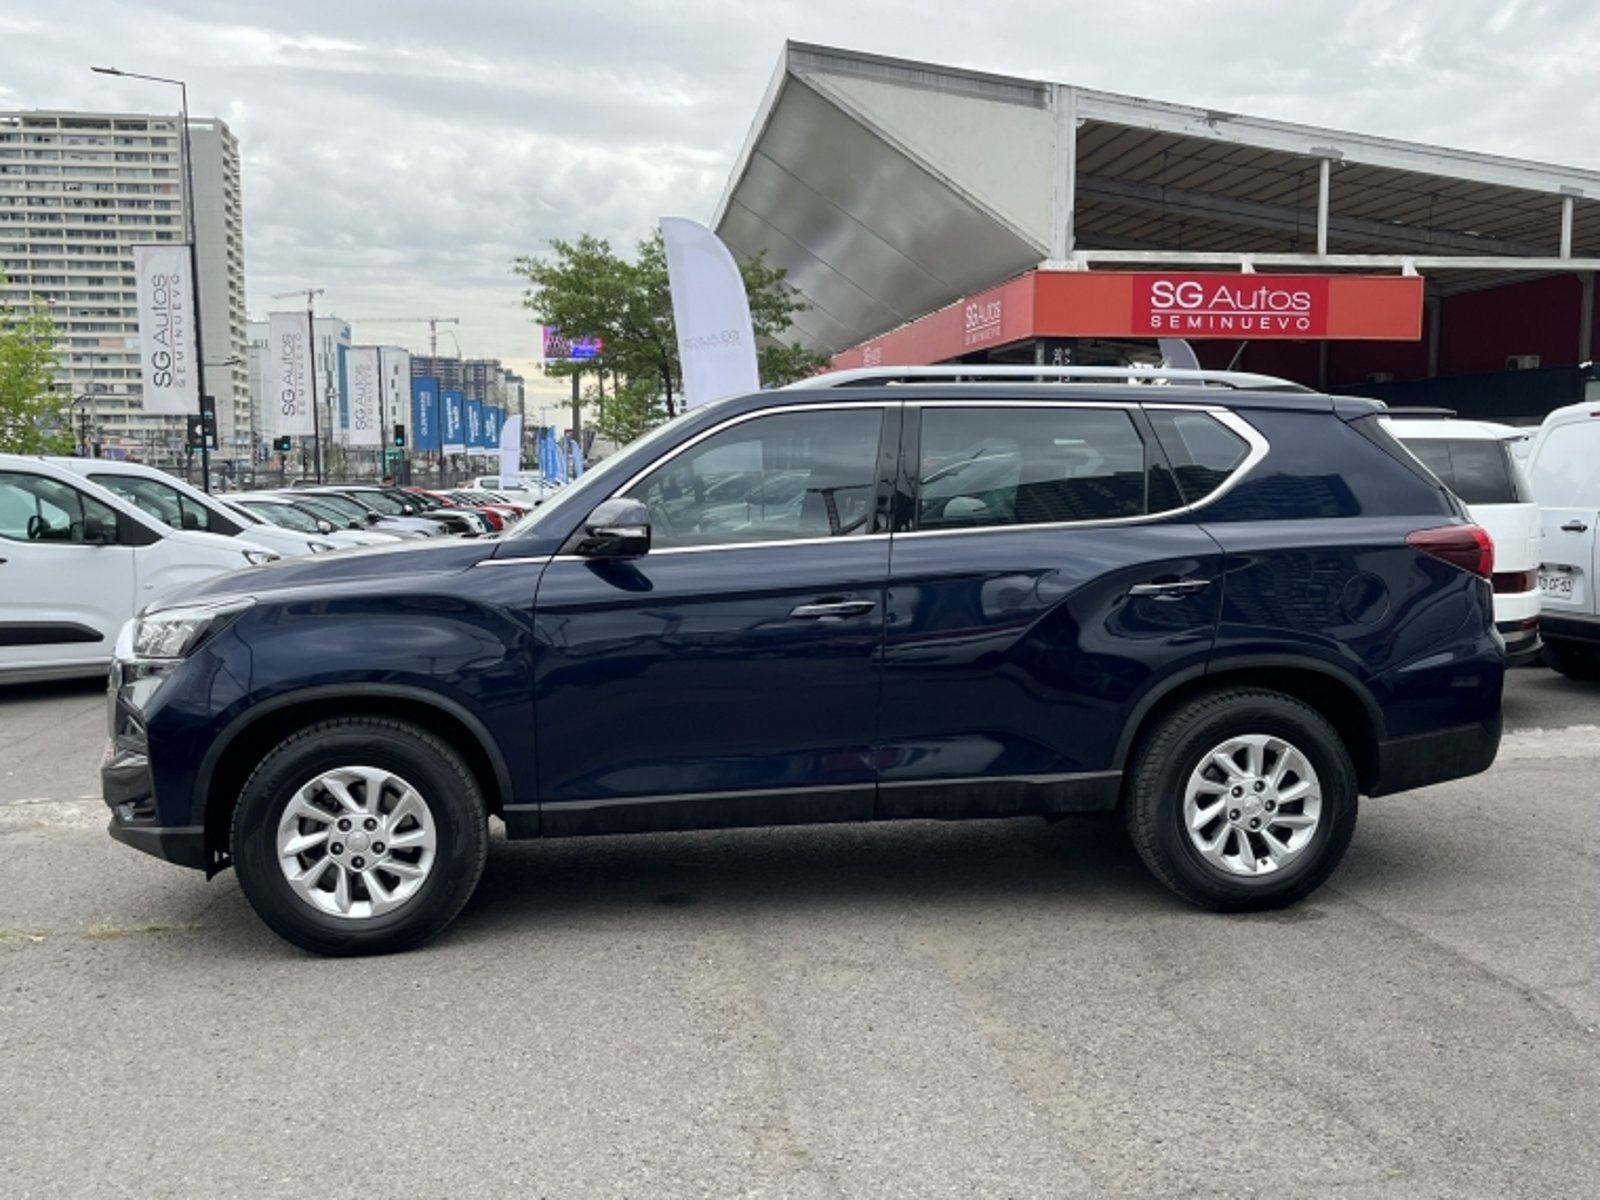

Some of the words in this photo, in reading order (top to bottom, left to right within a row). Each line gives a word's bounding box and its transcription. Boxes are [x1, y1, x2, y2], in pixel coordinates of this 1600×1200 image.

[151, 273, 171, 348] Autos
[1151, 280, 1204, 309] SG
[1208, 285, 1311, 310] Autos
[170, 273, 186, 388] SEMINUEVO
[1150, 315, 1311, 330] SEMINUEVO
[152, 351, 172, 388] SG
[281, 334, 294, 387] Autos
[281, 389, 296, 417] SG
